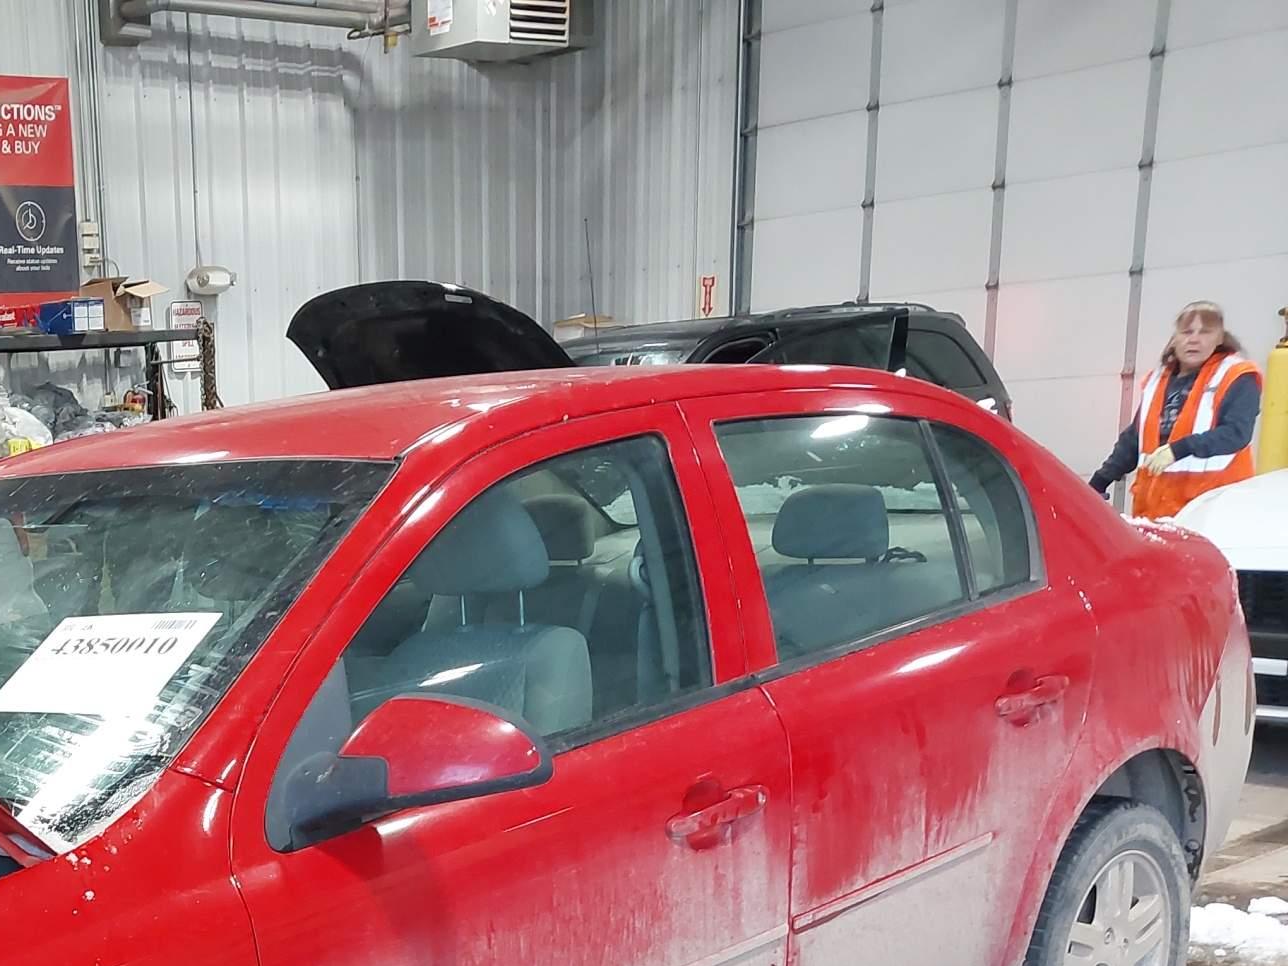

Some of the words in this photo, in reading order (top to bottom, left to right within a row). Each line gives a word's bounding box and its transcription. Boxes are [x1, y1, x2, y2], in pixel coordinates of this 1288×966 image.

[6, 123, 16, 137] A
[18, 123, 47, 138] NEW
[1, 139, 12, 154] &
[14, 140, 40, 155] BUY
[36, 245, 64, 256] Updates
[51, 636, 179, 655] 43850010
